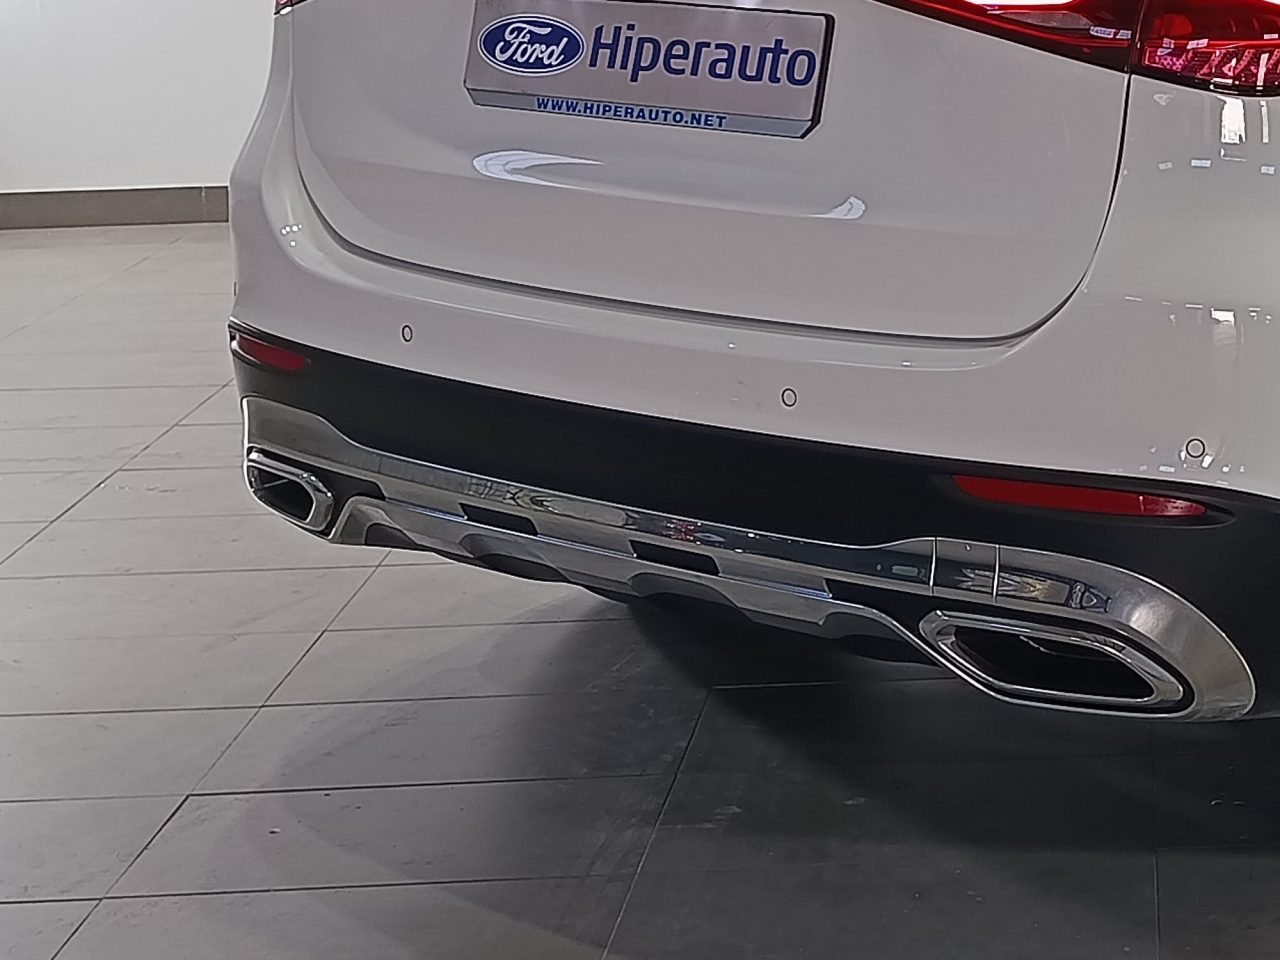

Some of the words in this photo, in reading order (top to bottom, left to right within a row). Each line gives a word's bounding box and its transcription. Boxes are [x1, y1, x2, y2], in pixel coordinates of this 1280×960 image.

[494, 21, 568, 66] Ford
[587, 23, 817, 87] Hiperauto
[535, 96, 728, 129] WWW.HIPERAUTO.NET
